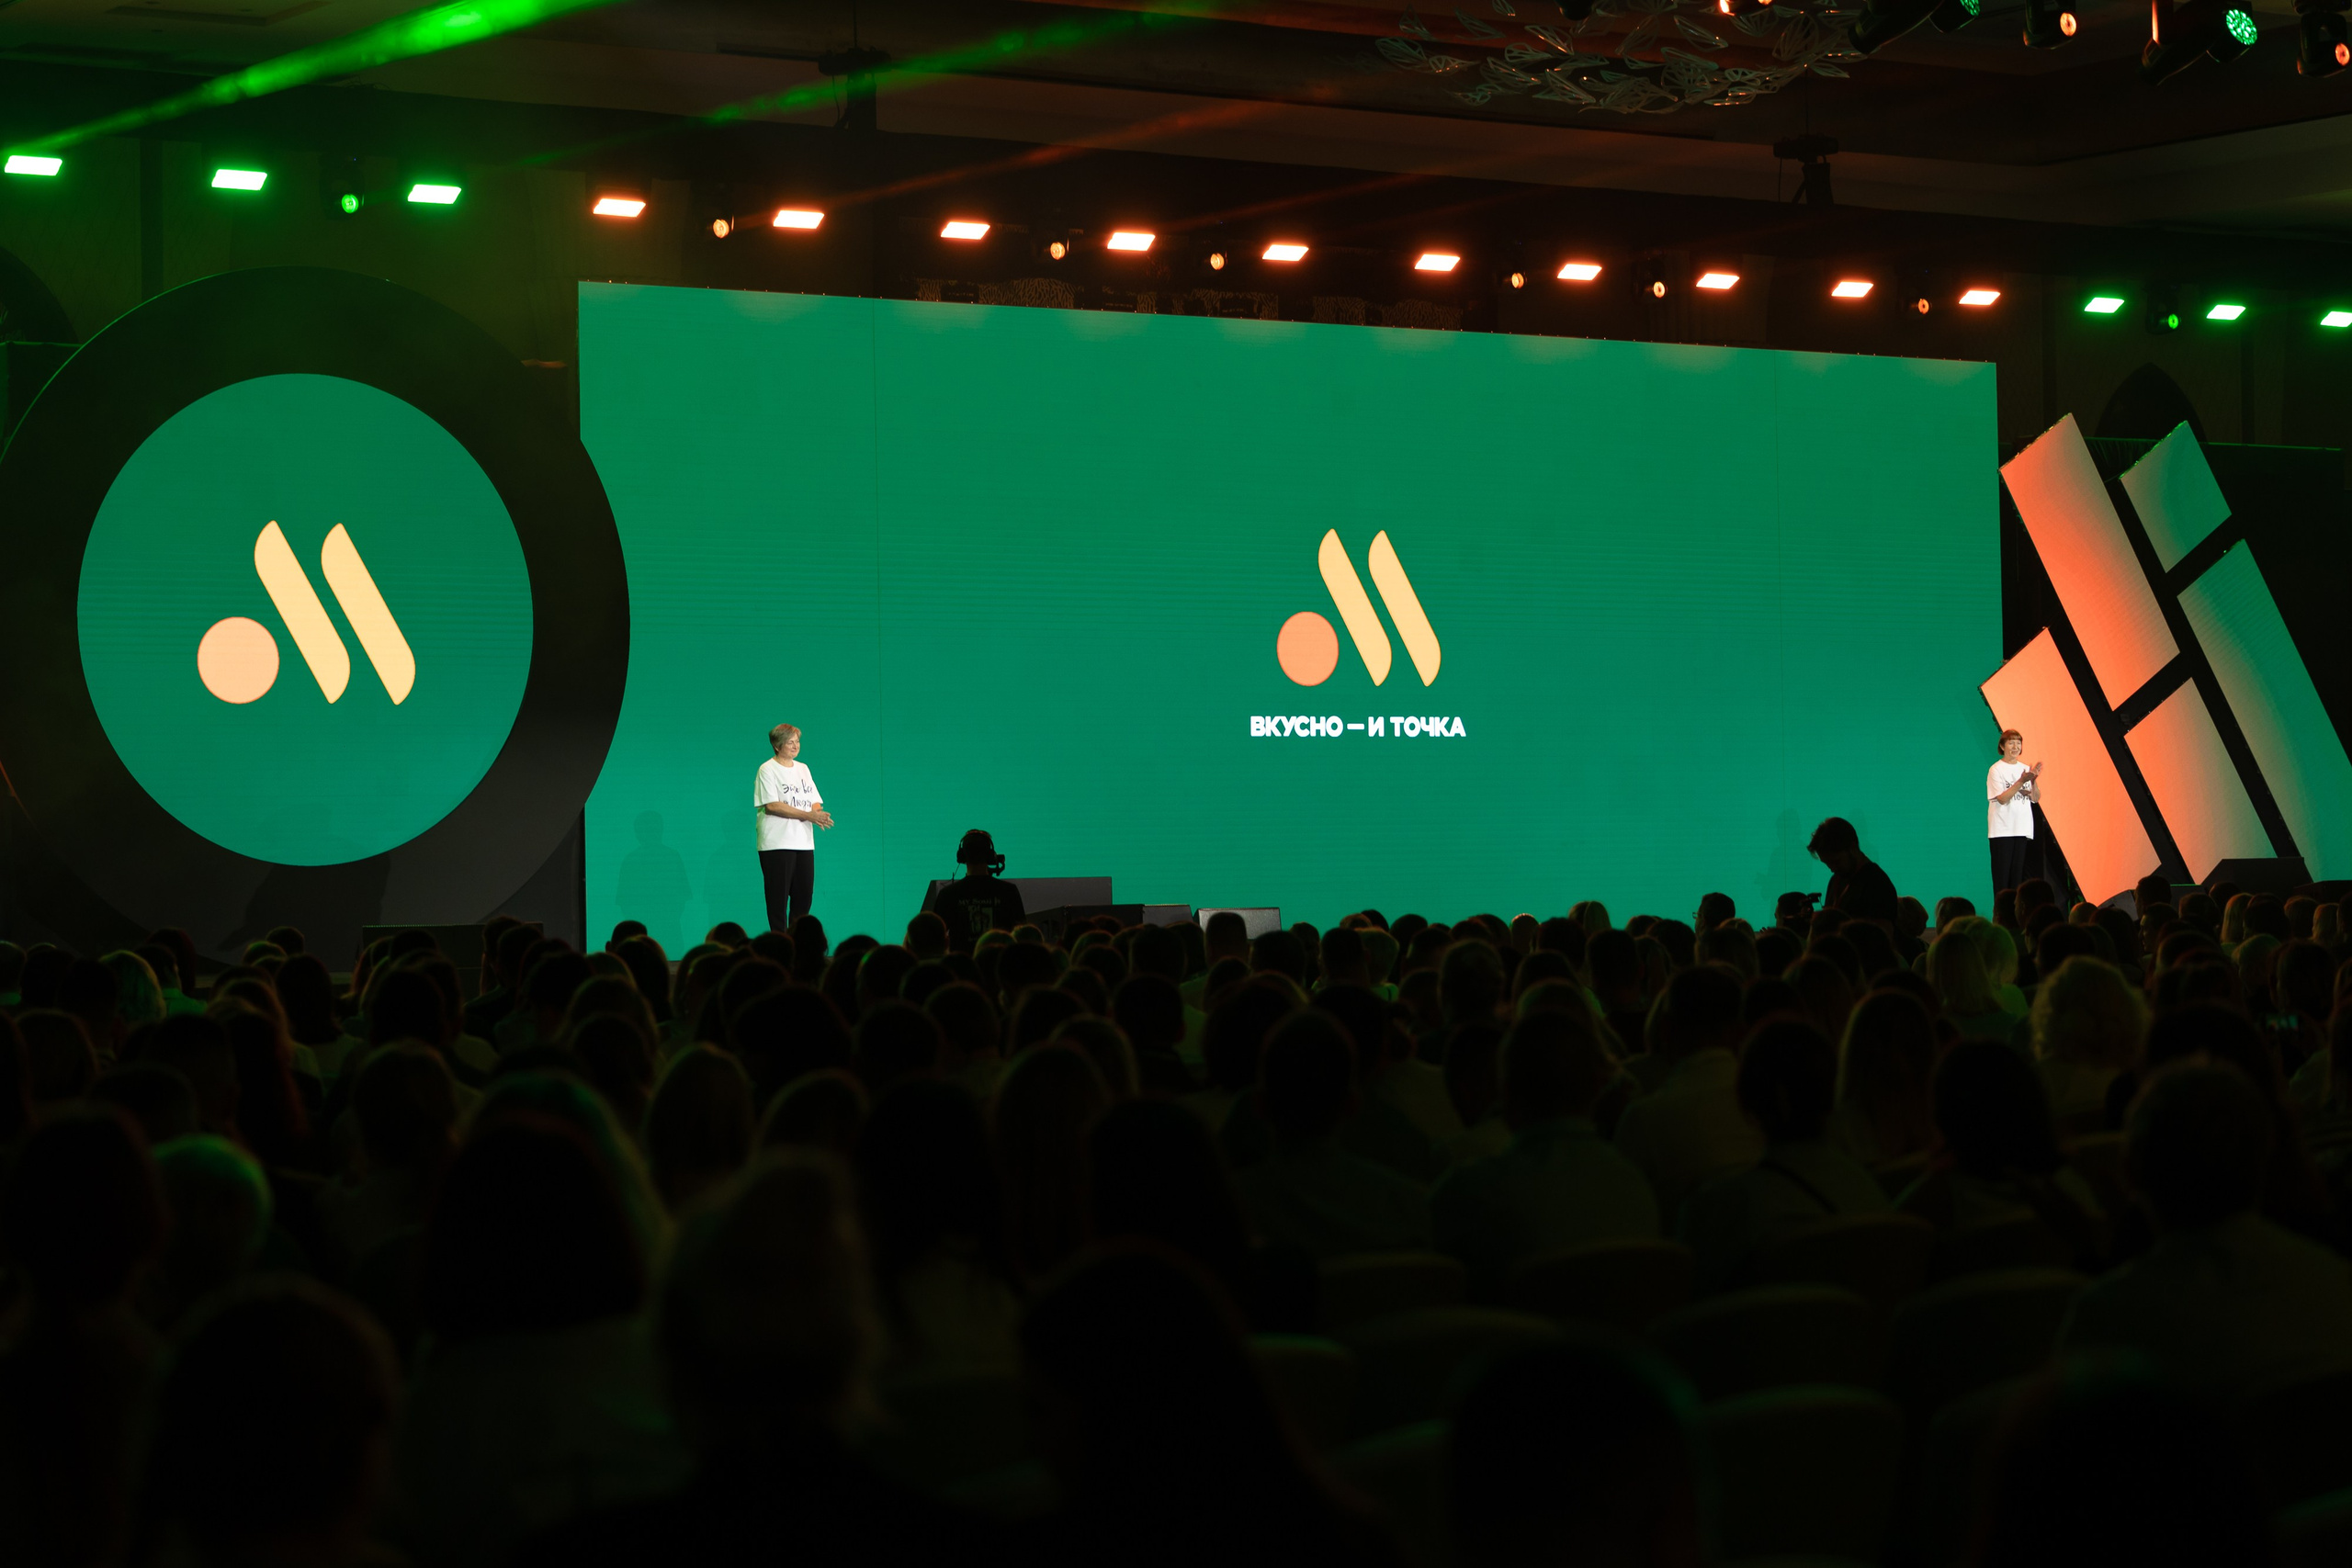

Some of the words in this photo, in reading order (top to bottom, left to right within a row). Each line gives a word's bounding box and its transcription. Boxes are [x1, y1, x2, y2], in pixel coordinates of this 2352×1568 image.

[1250, 715, 1343, 738] ВКУСНО
[1368, 716, 1385, 738] И
[1389, 716, 1467, 738] ТОЧКА
